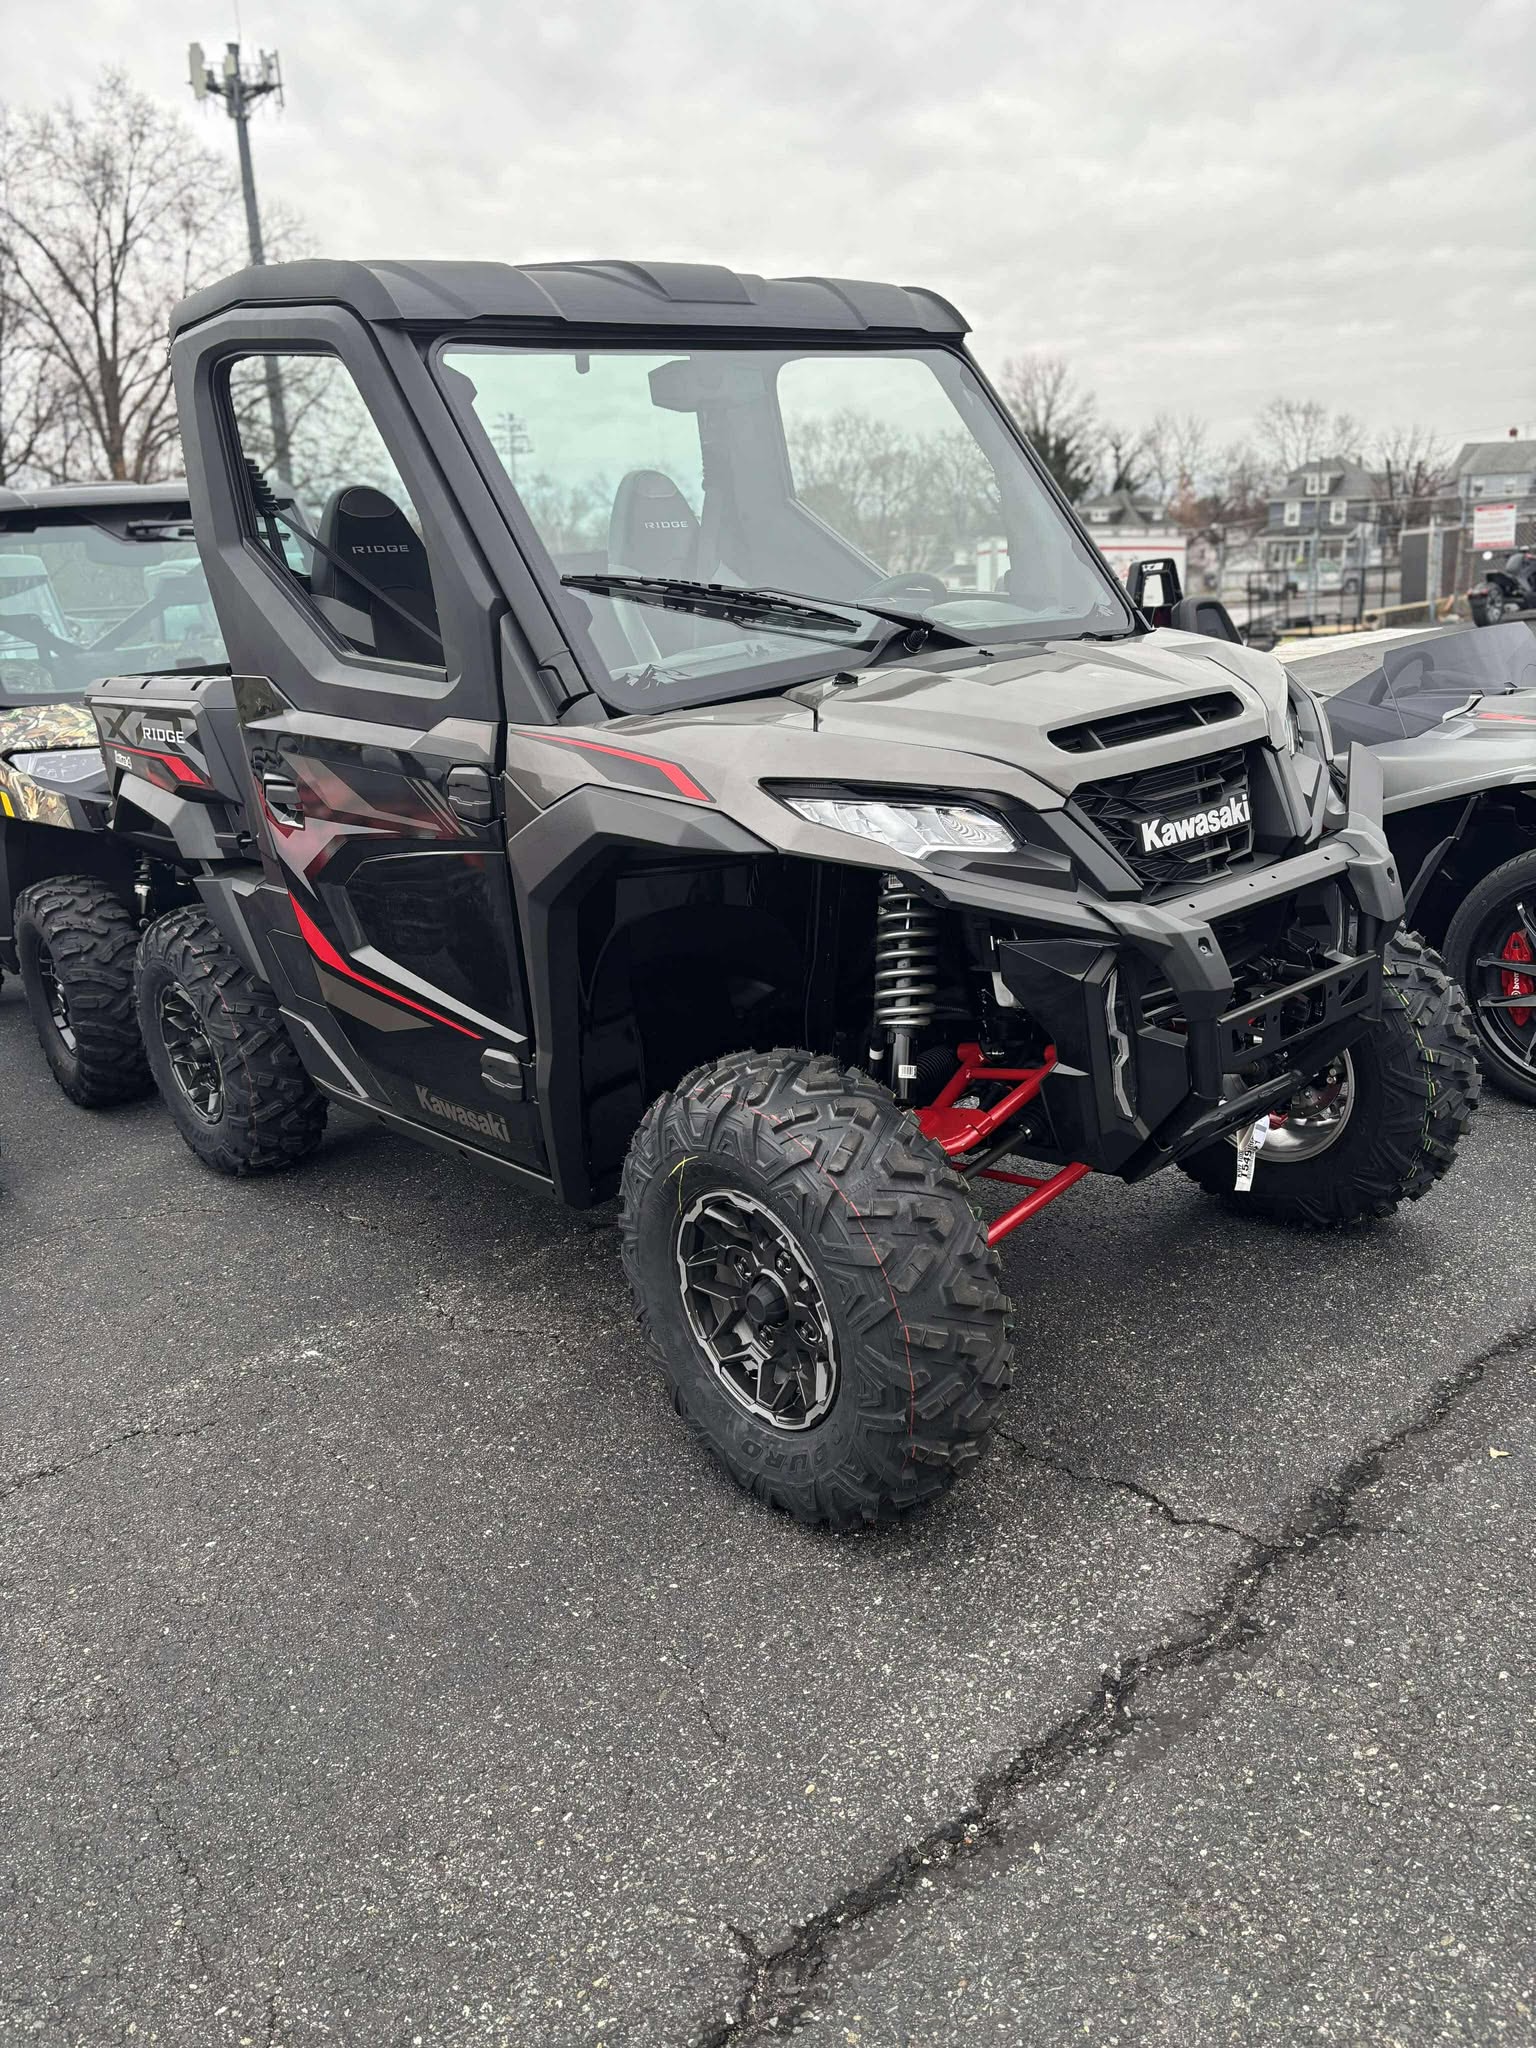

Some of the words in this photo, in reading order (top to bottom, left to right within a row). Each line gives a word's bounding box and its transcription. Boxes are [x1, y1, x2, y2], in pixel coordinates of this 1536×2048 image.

[644, 520, 689, 529] RIDGE
[351, 544, 410, 554] RIDGE
[142, 727, 186, 744] RIDGE
[1141, 793, 1251, 852] Kawasaki
[414, 1084, 511, 1143] Kawasaki
[741, 1439, 828, 1473] DURO
